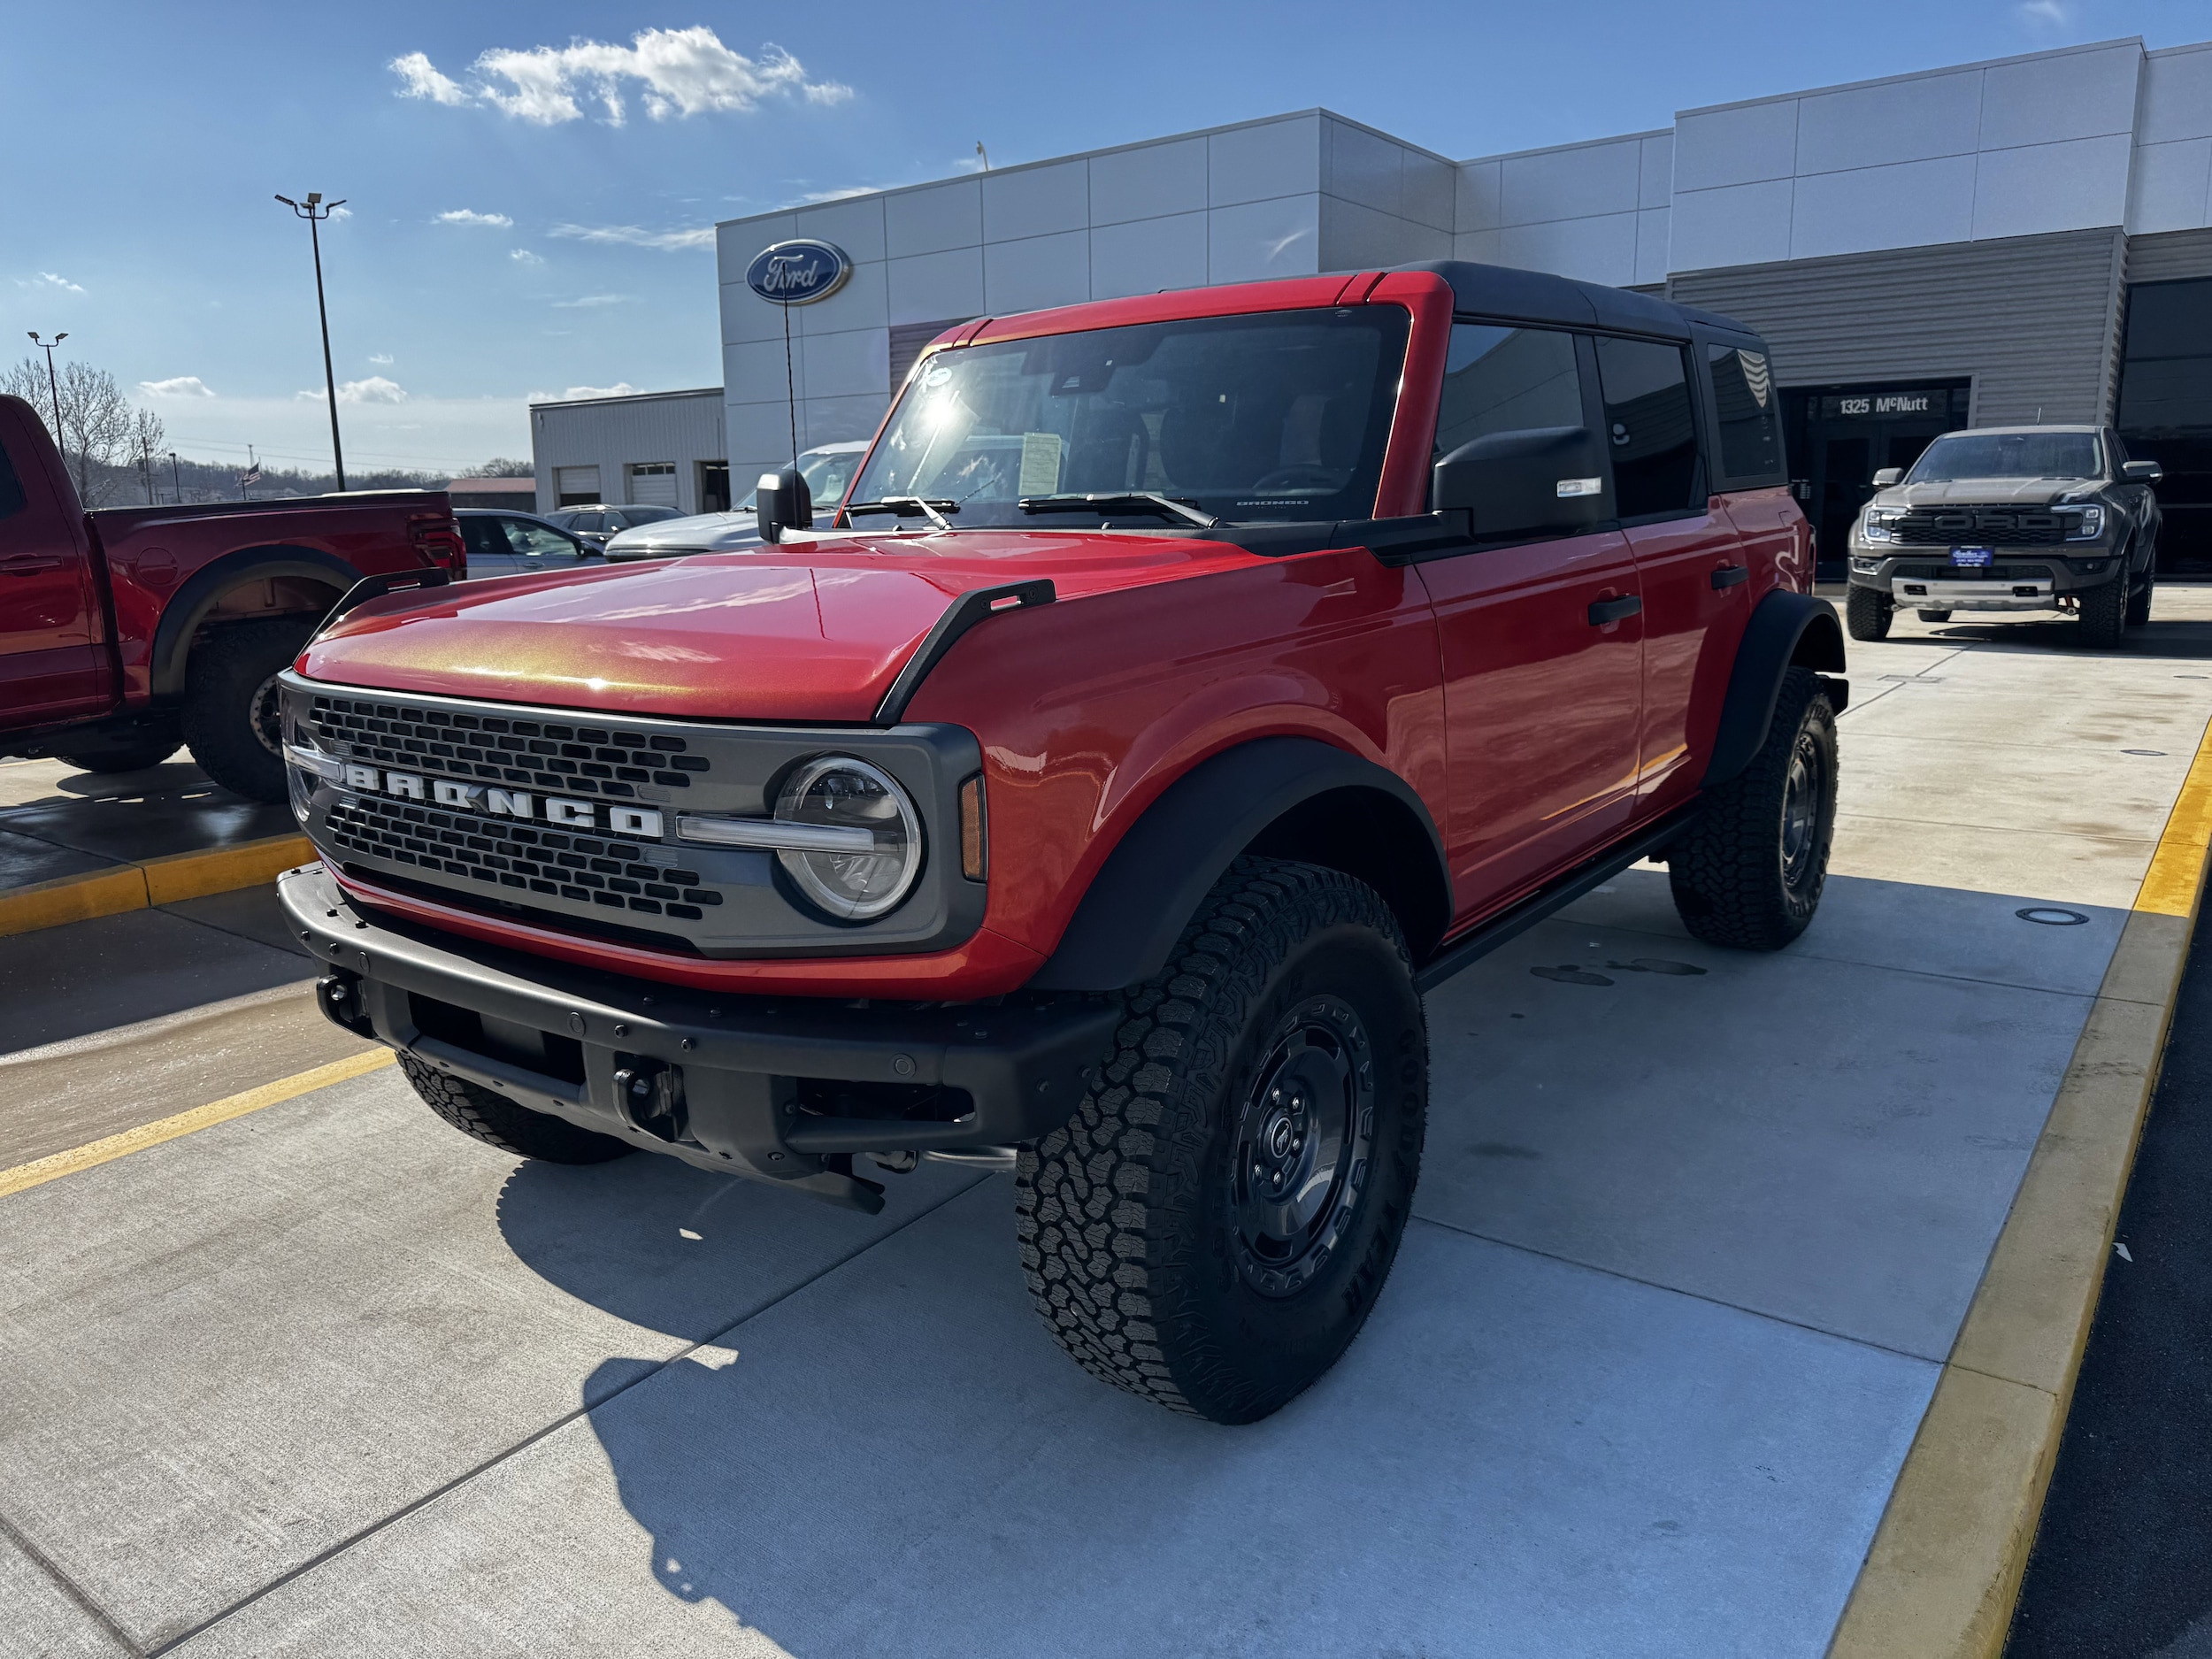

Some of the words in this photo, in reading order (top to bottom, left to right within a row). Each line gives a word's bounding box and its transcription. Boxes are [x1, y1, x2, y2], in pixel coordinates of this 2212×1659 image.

[764, 254, 819, 292] Ford
[1839, 398, 1870, 414] 1325
[1875, 396, 1929, 412] McNutt
[1894, 514, 2062, 530] FORD
[346, 764, 664, 838] BRONCO
